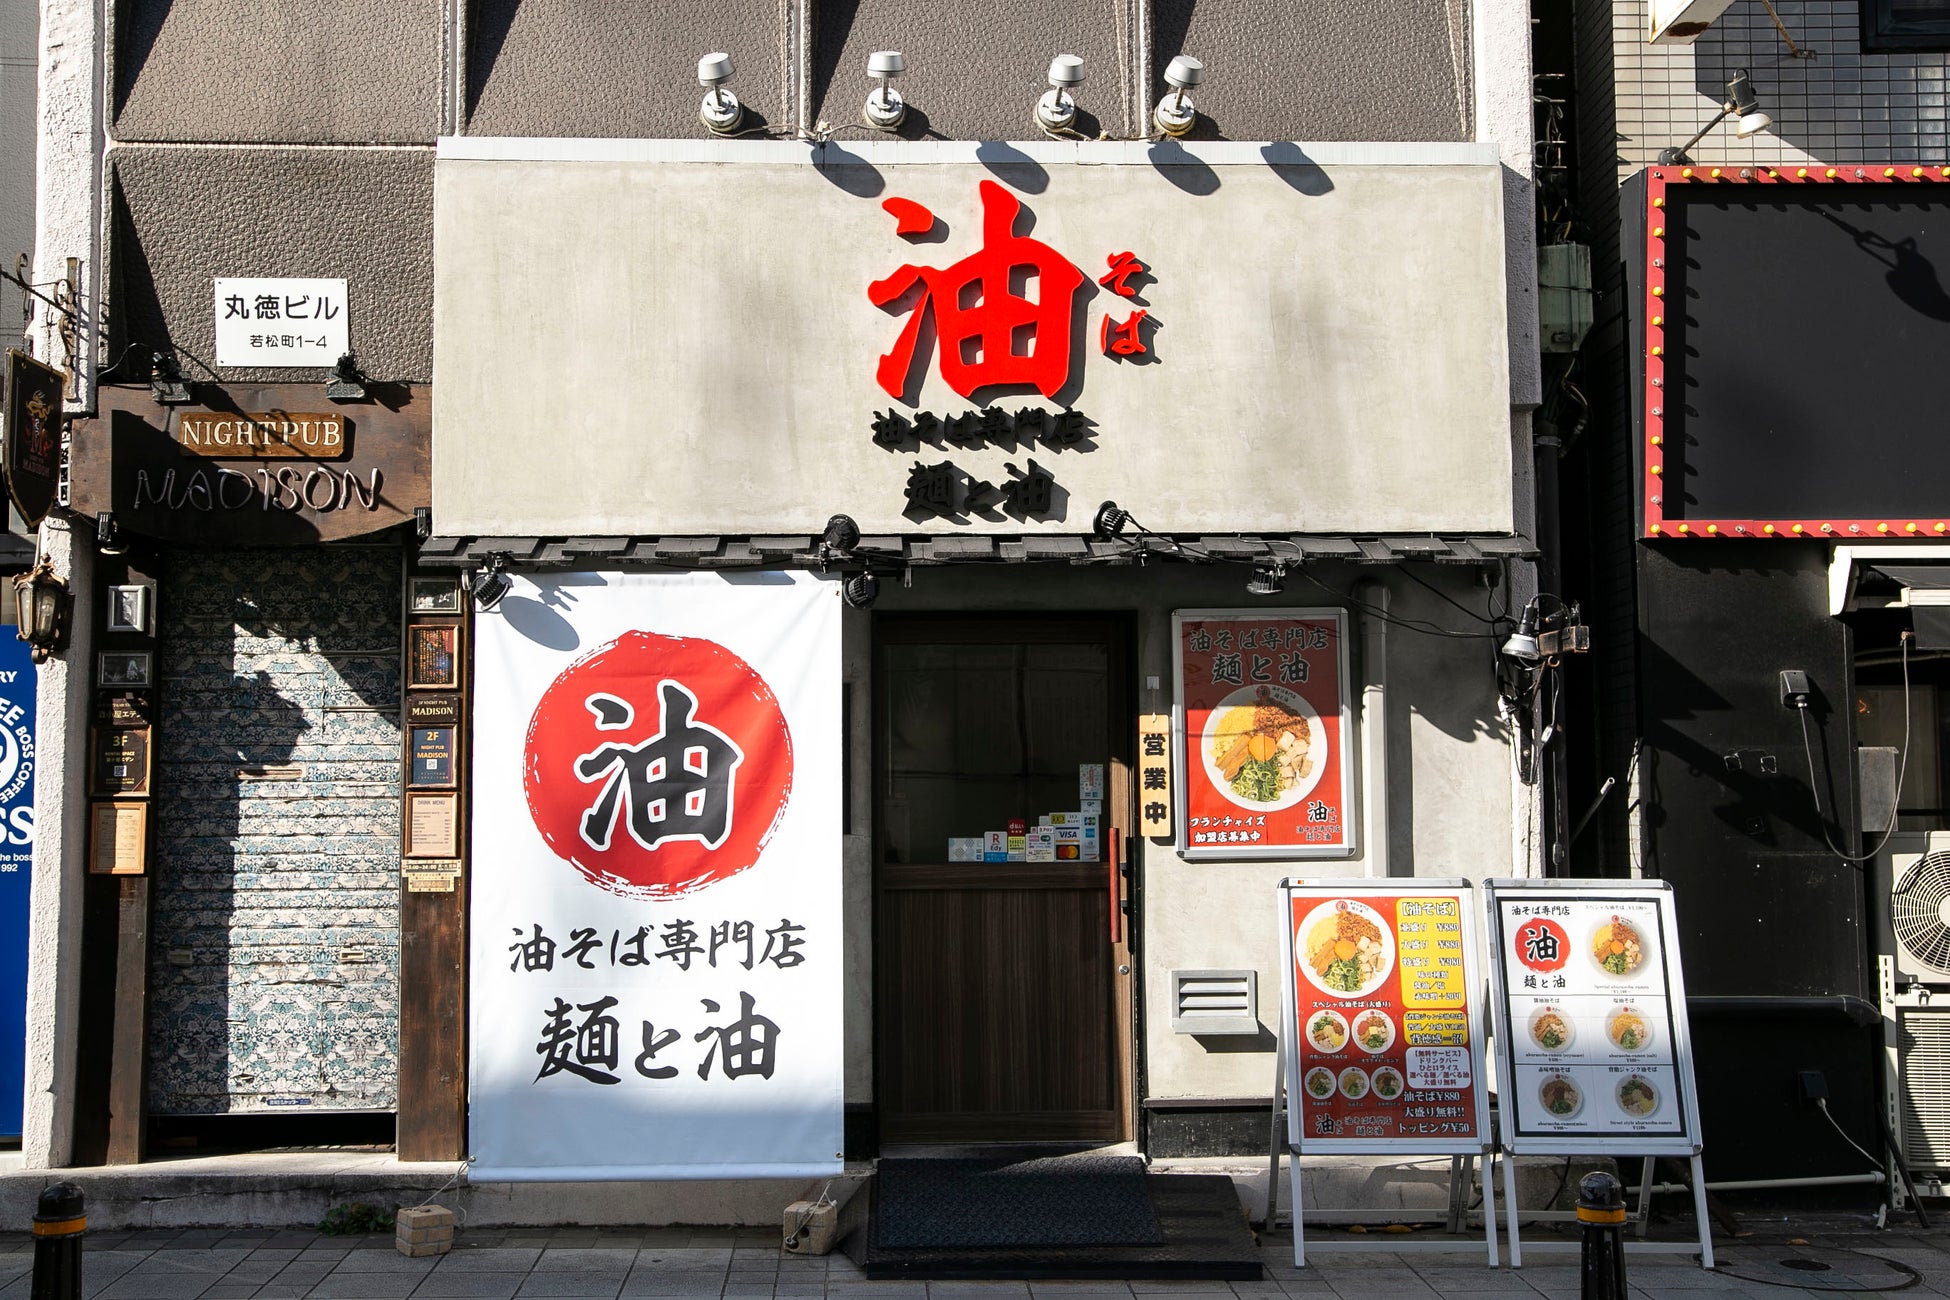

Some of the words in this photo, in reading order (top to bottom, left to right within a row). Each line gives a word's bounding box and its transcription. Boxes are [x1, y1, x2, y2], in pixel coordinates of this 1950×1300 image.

[868, 179, 1084, 398] 油
[223, 294, 339, 321] 丸徳ビル
[1098, 251, 1148, 355] そば
[183, 419, 277, 447] NIGHT
[279, 420, 341, 447] PUB
[870, 406, 1085, 445] 油そば専門店
[133, 467, 385, 512] MADISON
[903, 457, 1055, 516] 麺と油
[1189, 627, 1329, 652] 油そば専門店
[1211, 652, 1310, 685] 麺と油
[412, 707, 454, 716] MADISON
[112, 735, 129, 747] 3F
[426, 731, 439, 741] 2F
[576, 681, 744, 850] 油
[1142, 733, 1168, 824] 営業中
[1189, 815, 1267, 829] フランチャイズ
[1308, 801, 1328, 822] 油
[992, 833, 1001, 844] R
[1058, 831, 1078, 839] VISA
[1194, 831, 1261, 844] 加盟店募集中
[1511, 906, 1570, 917] 油そば専門店
[508, 918, 807, 973] 油そば専門店
[1526, 926, 1559, 961] 油
[1524, 975, 1566, 989] 麺と油
[532, 991, 782, 1087] 麺と油
[1316, 1112, 1335, 1134] 油
